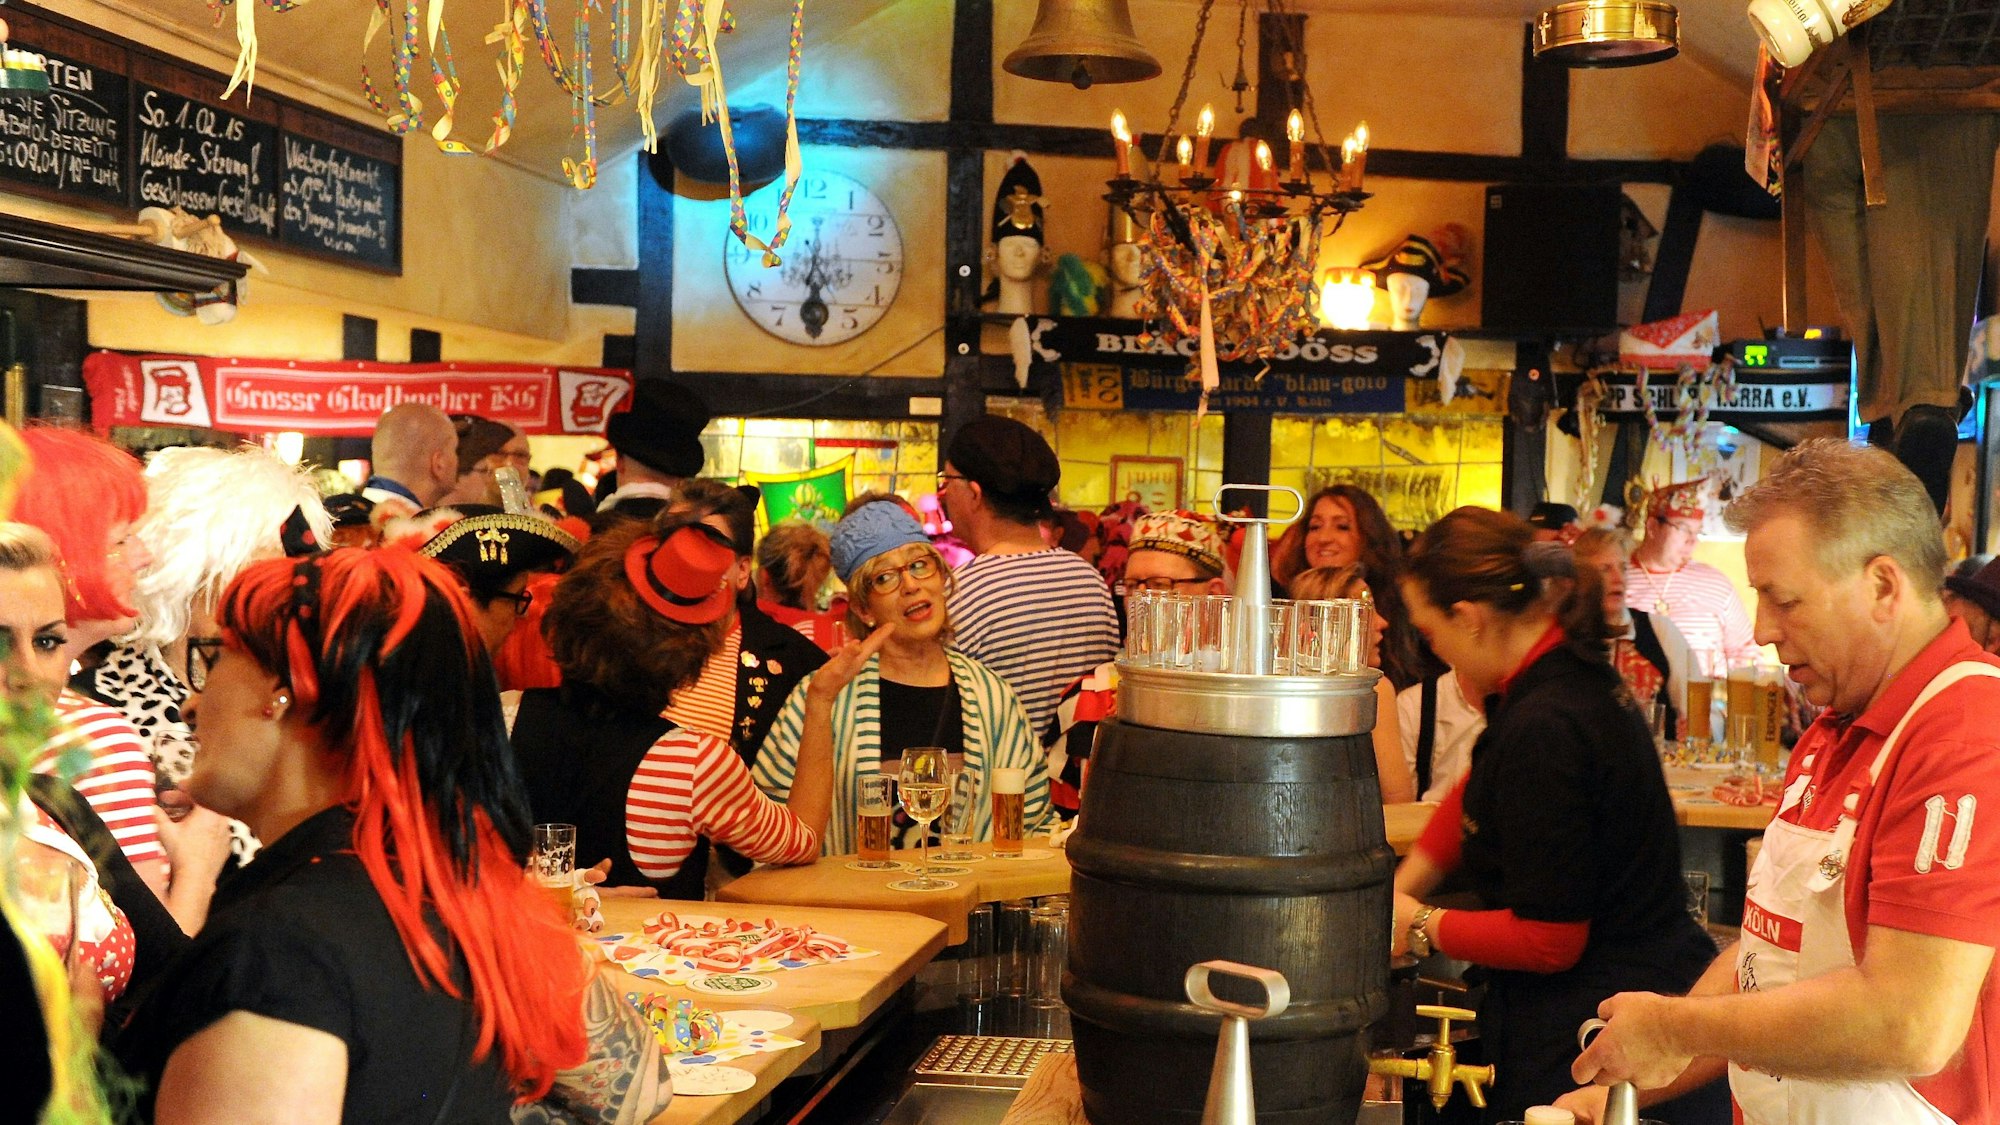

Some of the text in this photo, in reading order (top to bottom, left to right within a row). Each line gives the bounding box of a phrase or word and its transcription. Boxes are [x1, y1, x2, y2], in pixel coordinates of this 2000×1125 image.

[139, 90, 245, 141] So. 1.02.15
[93, 166, 121, 193] UHR
[805, 179, 828, 199] 12
[848, 190, 854, 210] 1
[1096, 329, 1379, 364] BLÄC ÖÖSS
[226, 380, 321, 412] Grosse
[489, 385, 539, 413] KG
[1782, 388, 1812, 409] e.V.
[1914, 793, 1977, 874] 11
[1744, 904, 1781, 943] KÖLN
